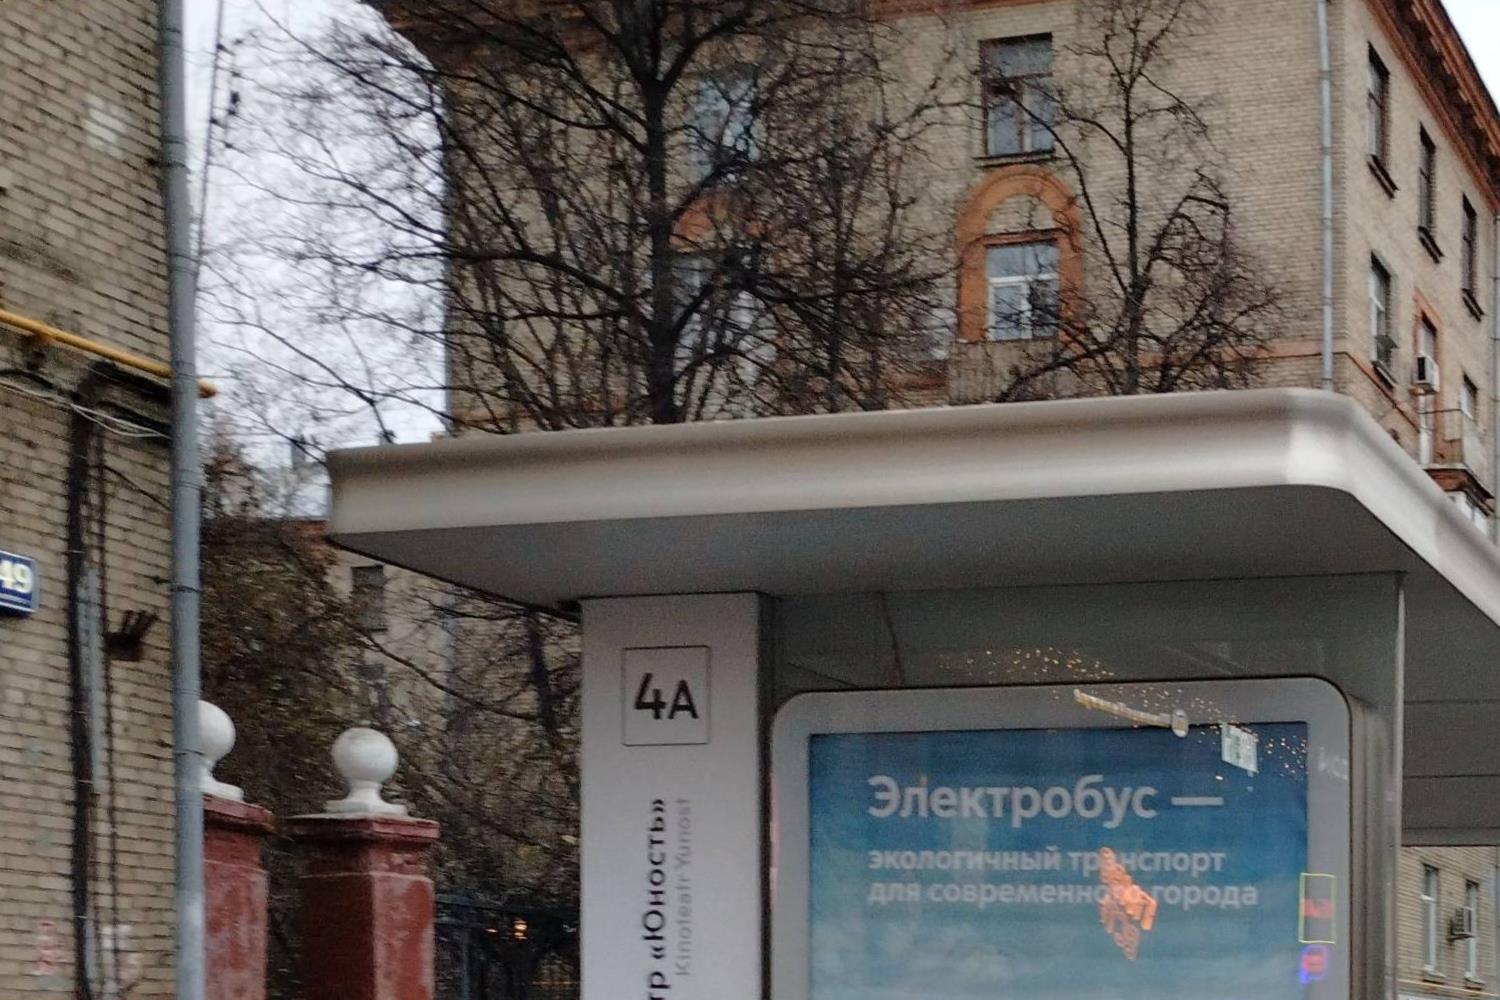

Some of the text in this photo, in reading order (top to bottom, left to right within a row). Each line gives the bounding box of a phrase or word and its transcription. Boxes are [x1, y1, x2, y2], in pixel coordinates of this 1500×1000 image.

[867, 774, 1158, 828] Электробус
[642, 799, 666, 959] «Юность»
[868, 845, 1060, 872] экологичный
[868, 882, 1260, 911] для современноо города
[674, 872, 693, 976] Kinoteatr
